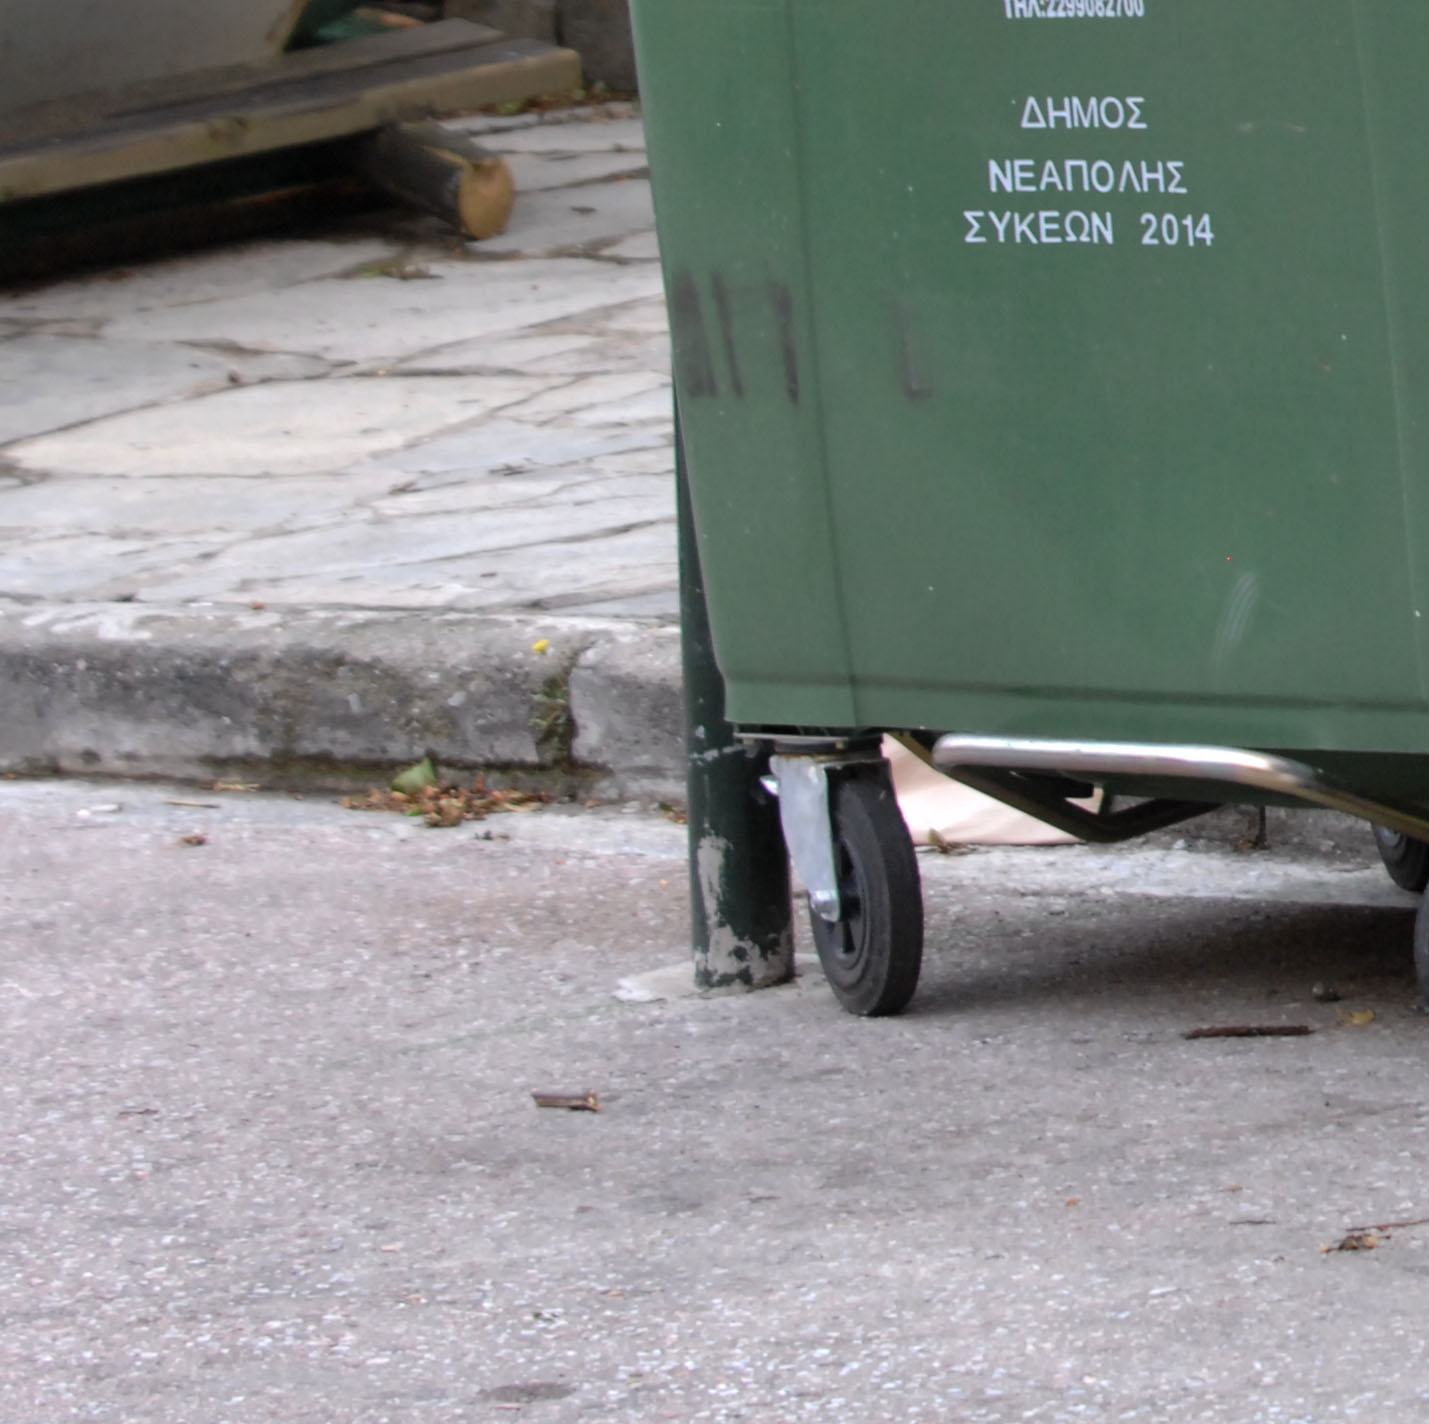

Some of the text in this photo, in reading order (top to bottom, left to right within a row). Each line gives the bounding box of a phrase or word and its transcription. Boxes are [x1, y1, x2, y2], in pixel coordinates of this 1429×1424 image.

[1021, 96, 1148, 129] ΔΗΜΟΣ
[988, 159, 1188, 194] ΝΕΑΠΟΛΗΣ
[963, 210, 1216, 247] ΣΥΚΕΩΝ 2014
